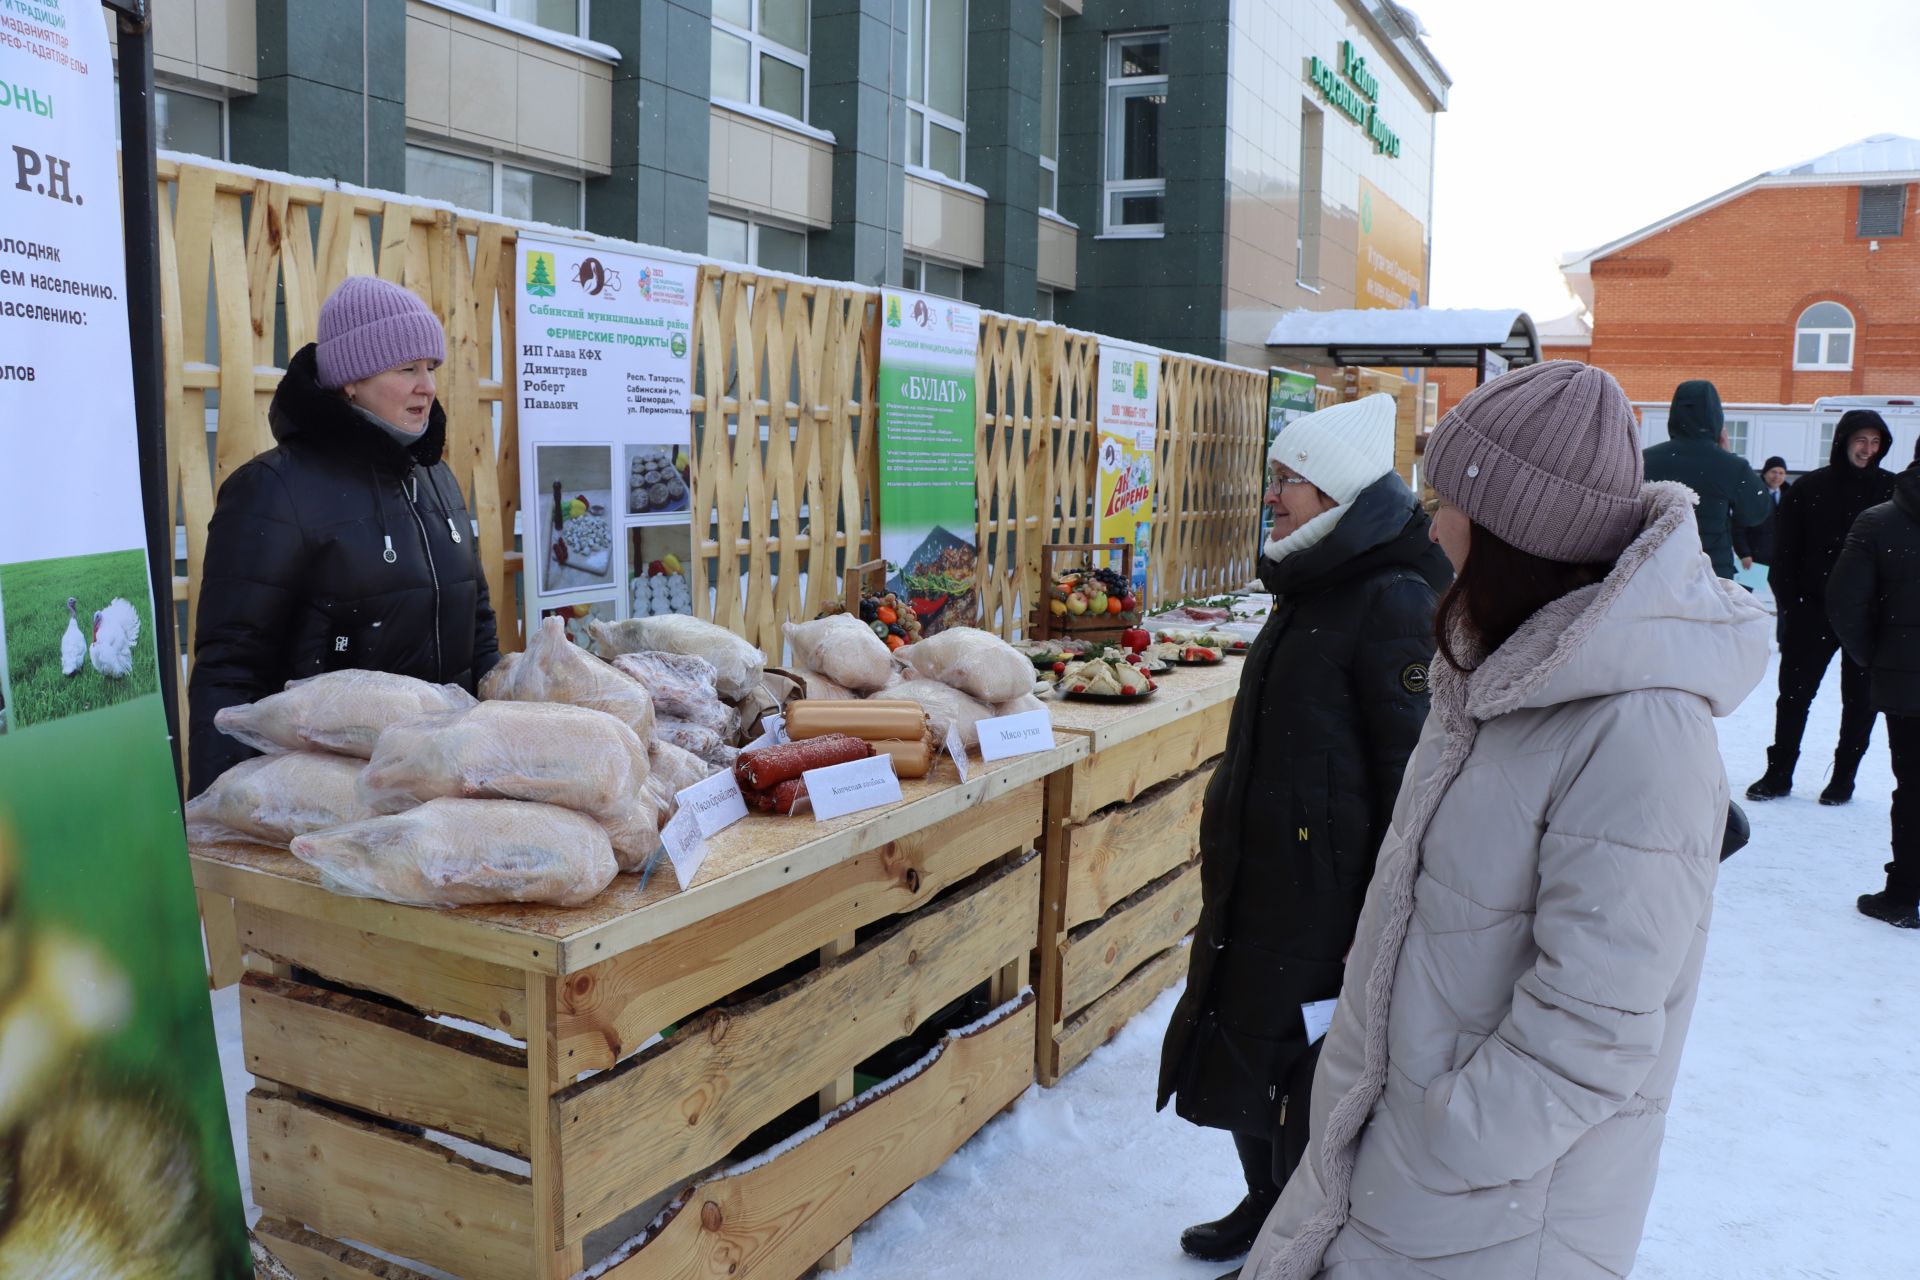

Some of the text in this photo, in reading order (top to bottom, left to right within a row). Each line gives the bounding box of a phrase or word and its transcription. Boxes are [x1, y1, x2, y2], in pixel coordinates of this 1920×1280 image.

[15, 0, 66, 30] ТРАДИЦИЙ
[70, 58, 88, 75] ЕЛЫ
[1344, 40, 1378, 104] Район
[12, 145, 83, 206] Р.Н.
[0, 237, 61, 262] лодняк
[31, 273, 117, 300] населению.
[529, 304, 689, 330] Сабинский муниципальный район
[546, 328, 669, 348] ФЕРМЕРСКИЕ ПРОДУКТЫ
[522, 345, 602, 361] ИП Глава КФХ
[522, 363, 588, 378] Димитриев
[627, 373, 685, 384] Респ. Татарстан,
[523, 380, 565, 395] Роберт
[627, 384, 667, 394] Сабинский
[901, 376, 967, 403] «БУЛАТ»
[524, 398, 579, 410] Павлович
[628, 406, 637, 415] ул.
[639, 406, 684, 416] Лермонтова,
[1113, 484, 1149, 514] СИРЕНЬ
[1000, 727, 1040, 742] Мясо утки
[1299, 827, 1308, 841] N
